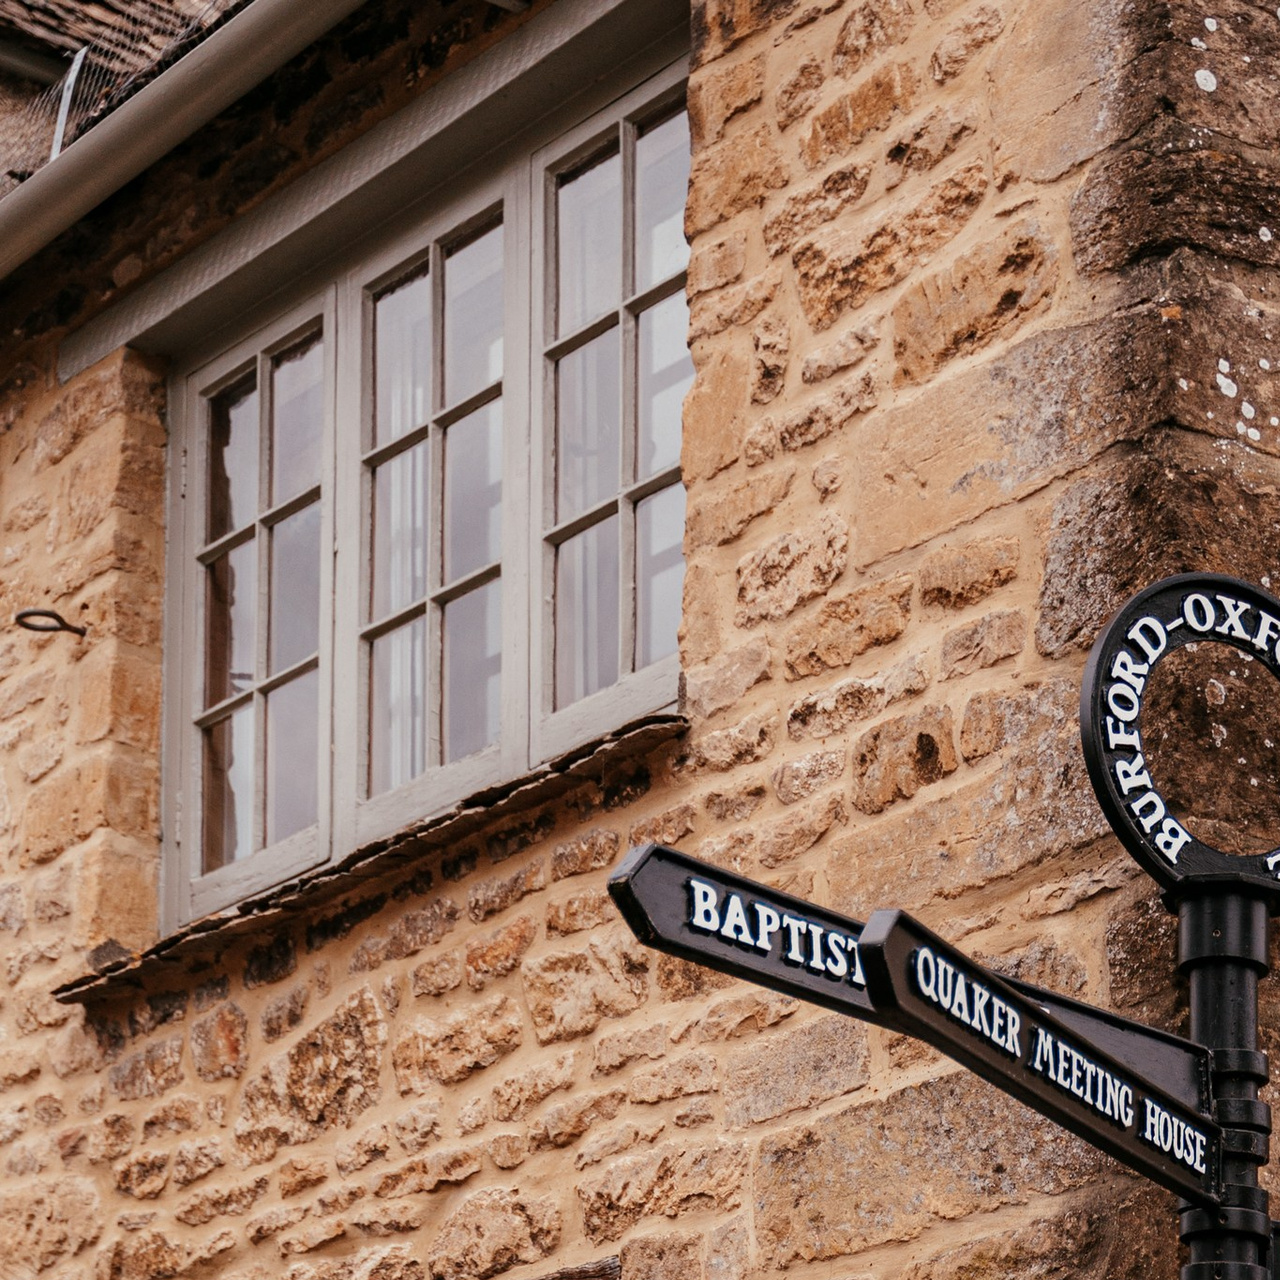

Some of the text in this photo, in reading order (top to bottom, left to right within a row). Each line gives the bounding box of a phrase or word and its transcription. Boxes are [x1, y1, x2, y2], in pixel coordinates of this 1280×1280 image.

[690, 879, 867, 986] BAPTIST
[917, 947, 1207, 1174] QUAKER MEETING HOUSE
